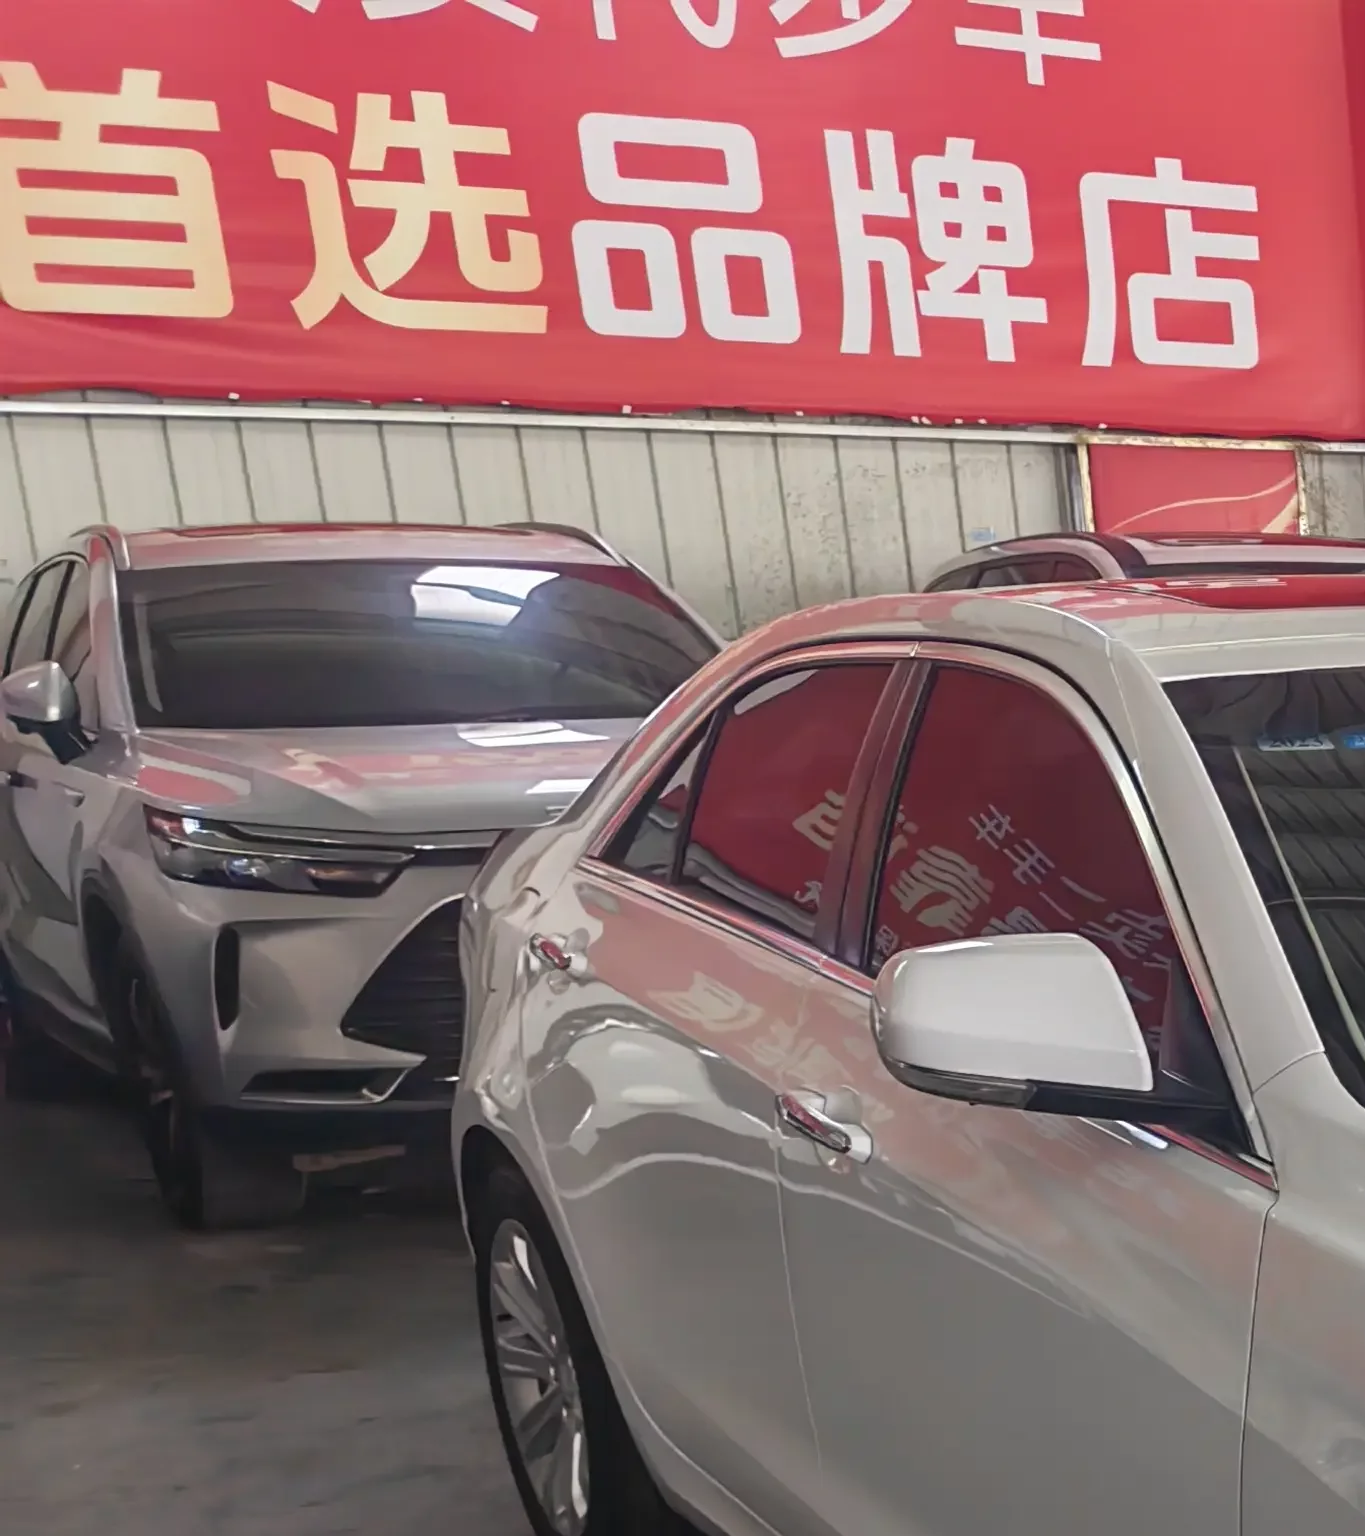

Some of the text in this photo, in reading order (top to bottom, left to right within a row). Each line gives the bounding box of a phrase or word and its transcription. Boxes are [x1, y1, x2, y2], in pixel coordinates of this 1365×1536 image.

[0, 60, 1260, 370] 首选品牌店
